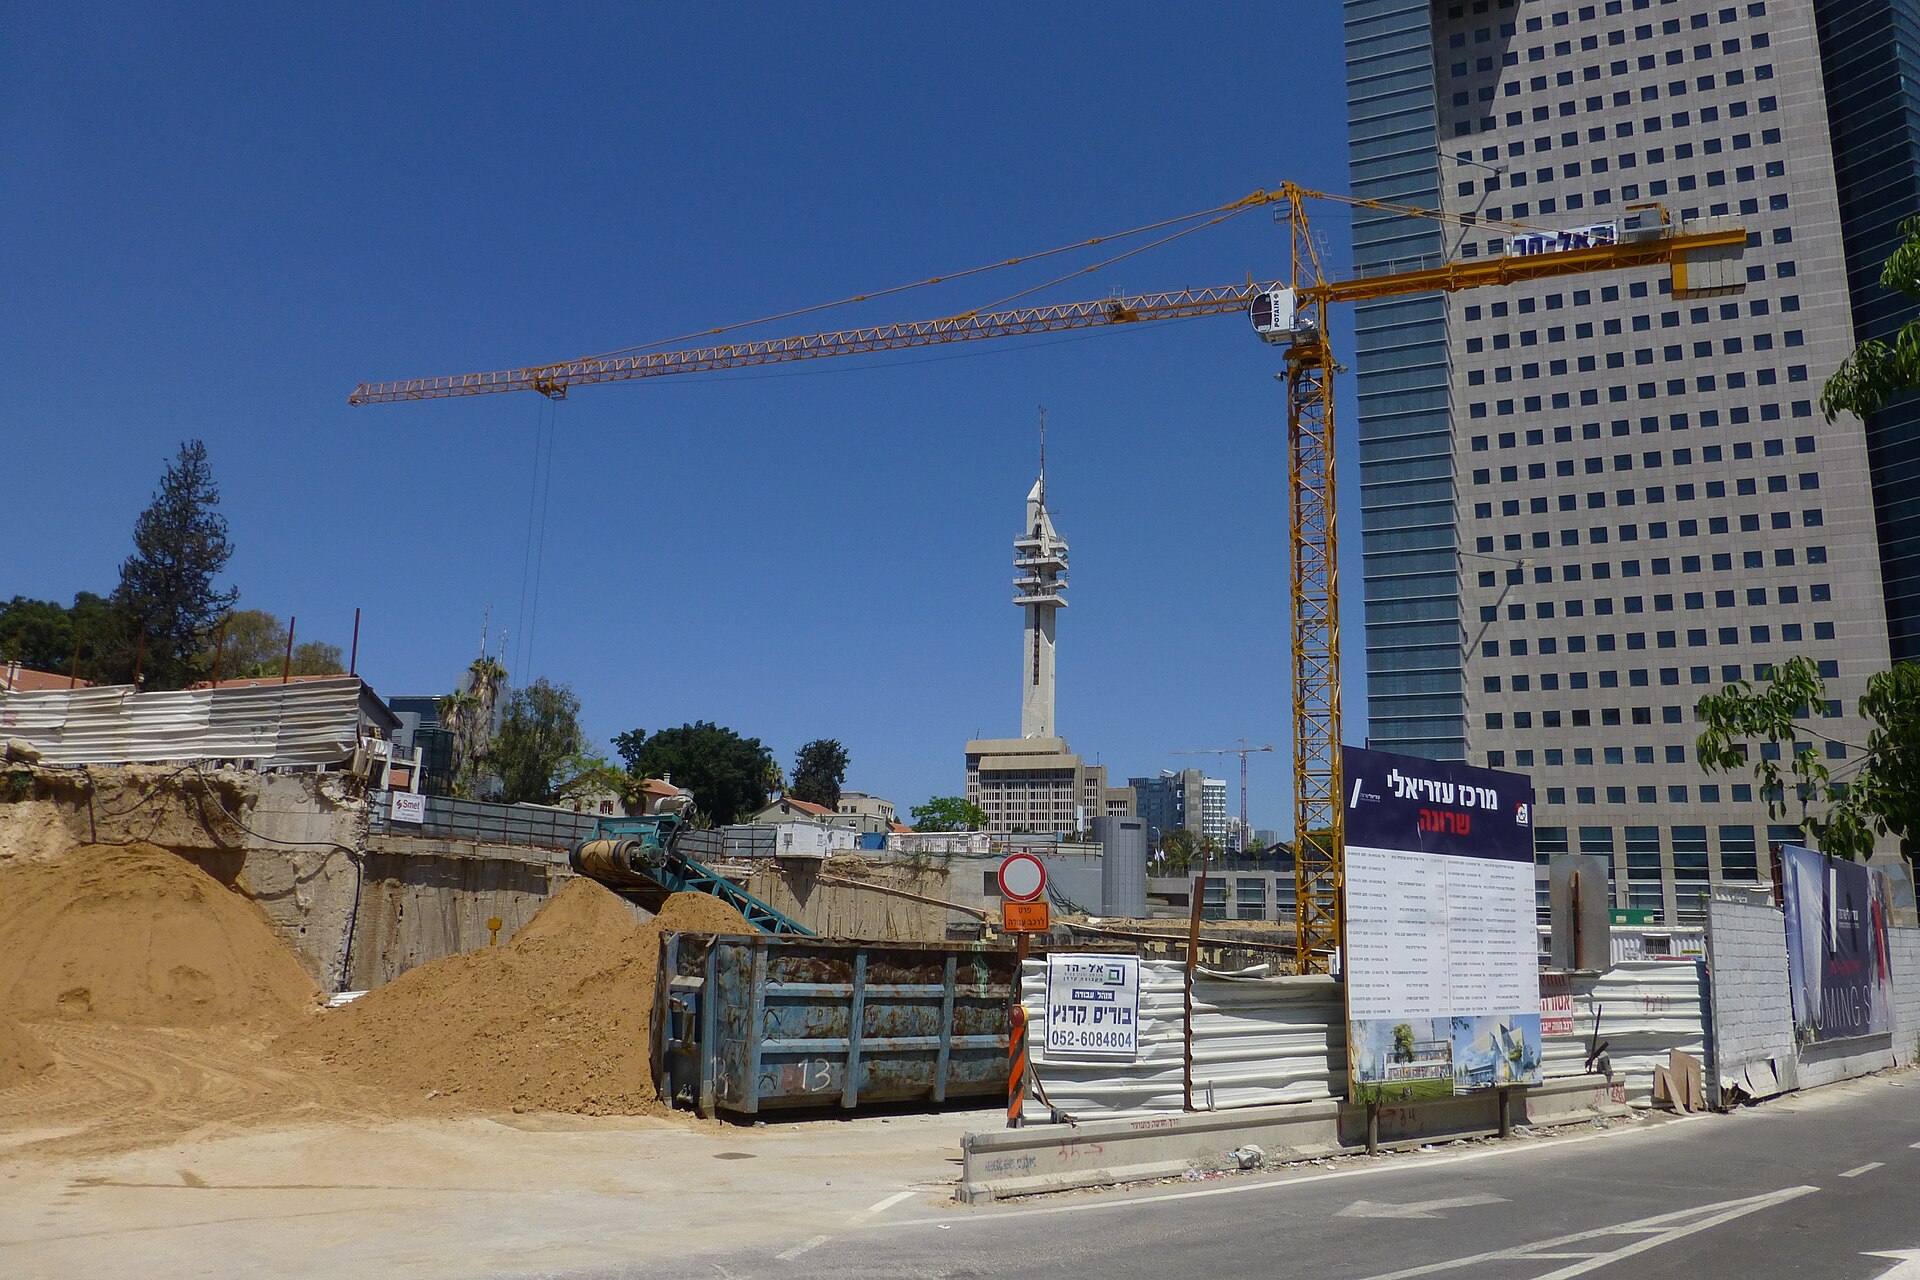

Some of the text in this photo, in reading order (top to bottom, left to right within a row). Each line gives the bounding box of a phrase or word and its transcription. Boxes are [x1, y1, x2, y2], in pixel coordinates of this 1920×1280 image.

[1387, 768, 1498, 811] מרכז עזריאלי
[402, 799, 420, 810] Smet
[1419, 808, 1471, 836] שרונה
[1028, 918, 1045, 926] לרכב
[1097, 991, 1113, 999] מנהל
[1052, 1004, 1132, 1026] בוריס קרנץ
[1051, 1030, 1132, 1047] 052-6084804
[798, 1058, 831, 1092] 13
